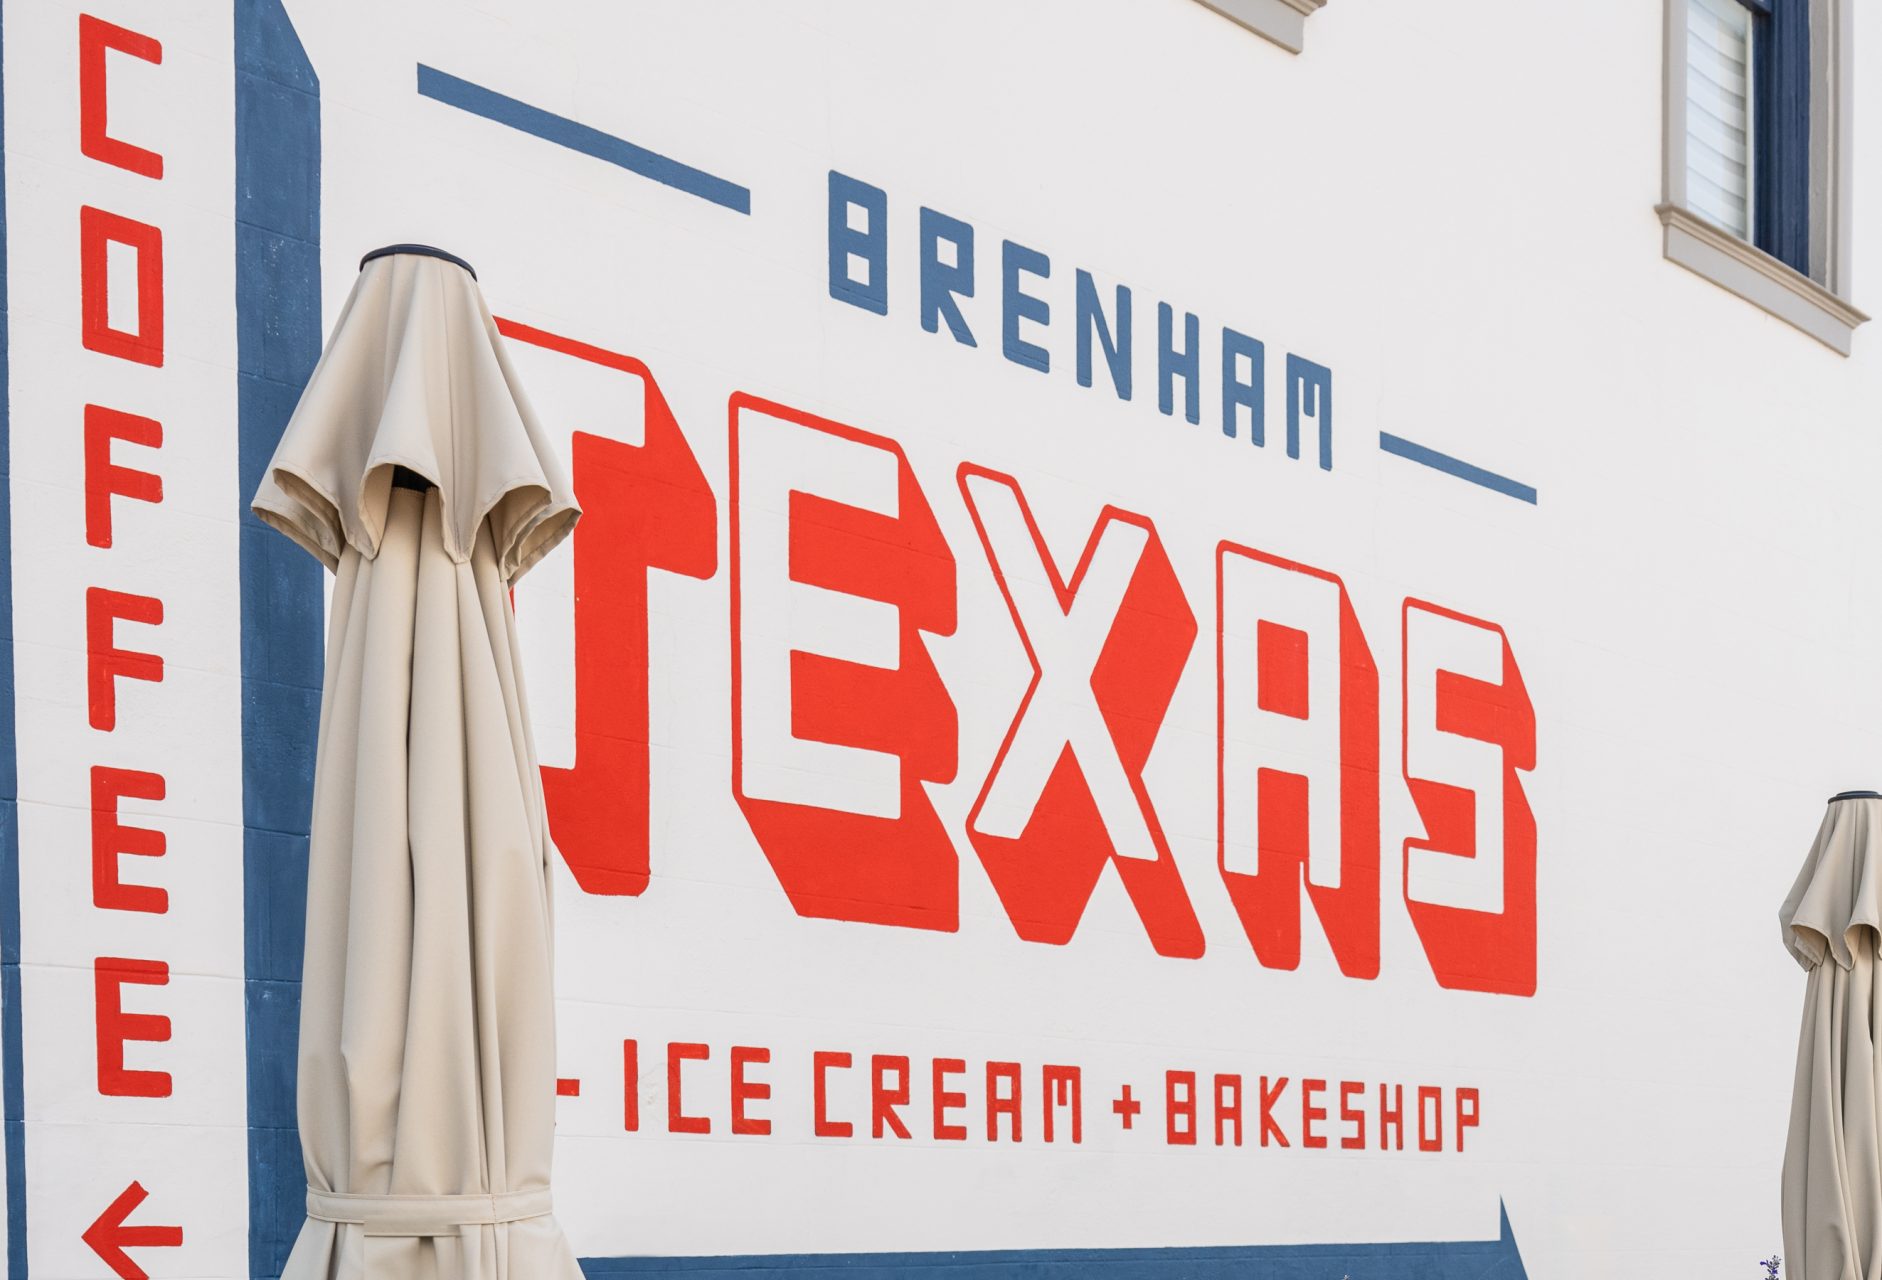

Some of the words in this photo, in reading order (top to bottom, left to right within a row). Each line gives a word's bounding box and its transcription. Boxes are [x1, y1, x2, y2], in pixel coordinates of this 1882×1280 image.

[828, 169, 1332, 471] BRENHAM
[79, 13, 172, 1099] COFFEE
[623, 1039, 772, 1136] ICE
[813, 1051, 1082, 1144] CREAM
[1165, 1069, 1480, 1153] BAKESHOP
